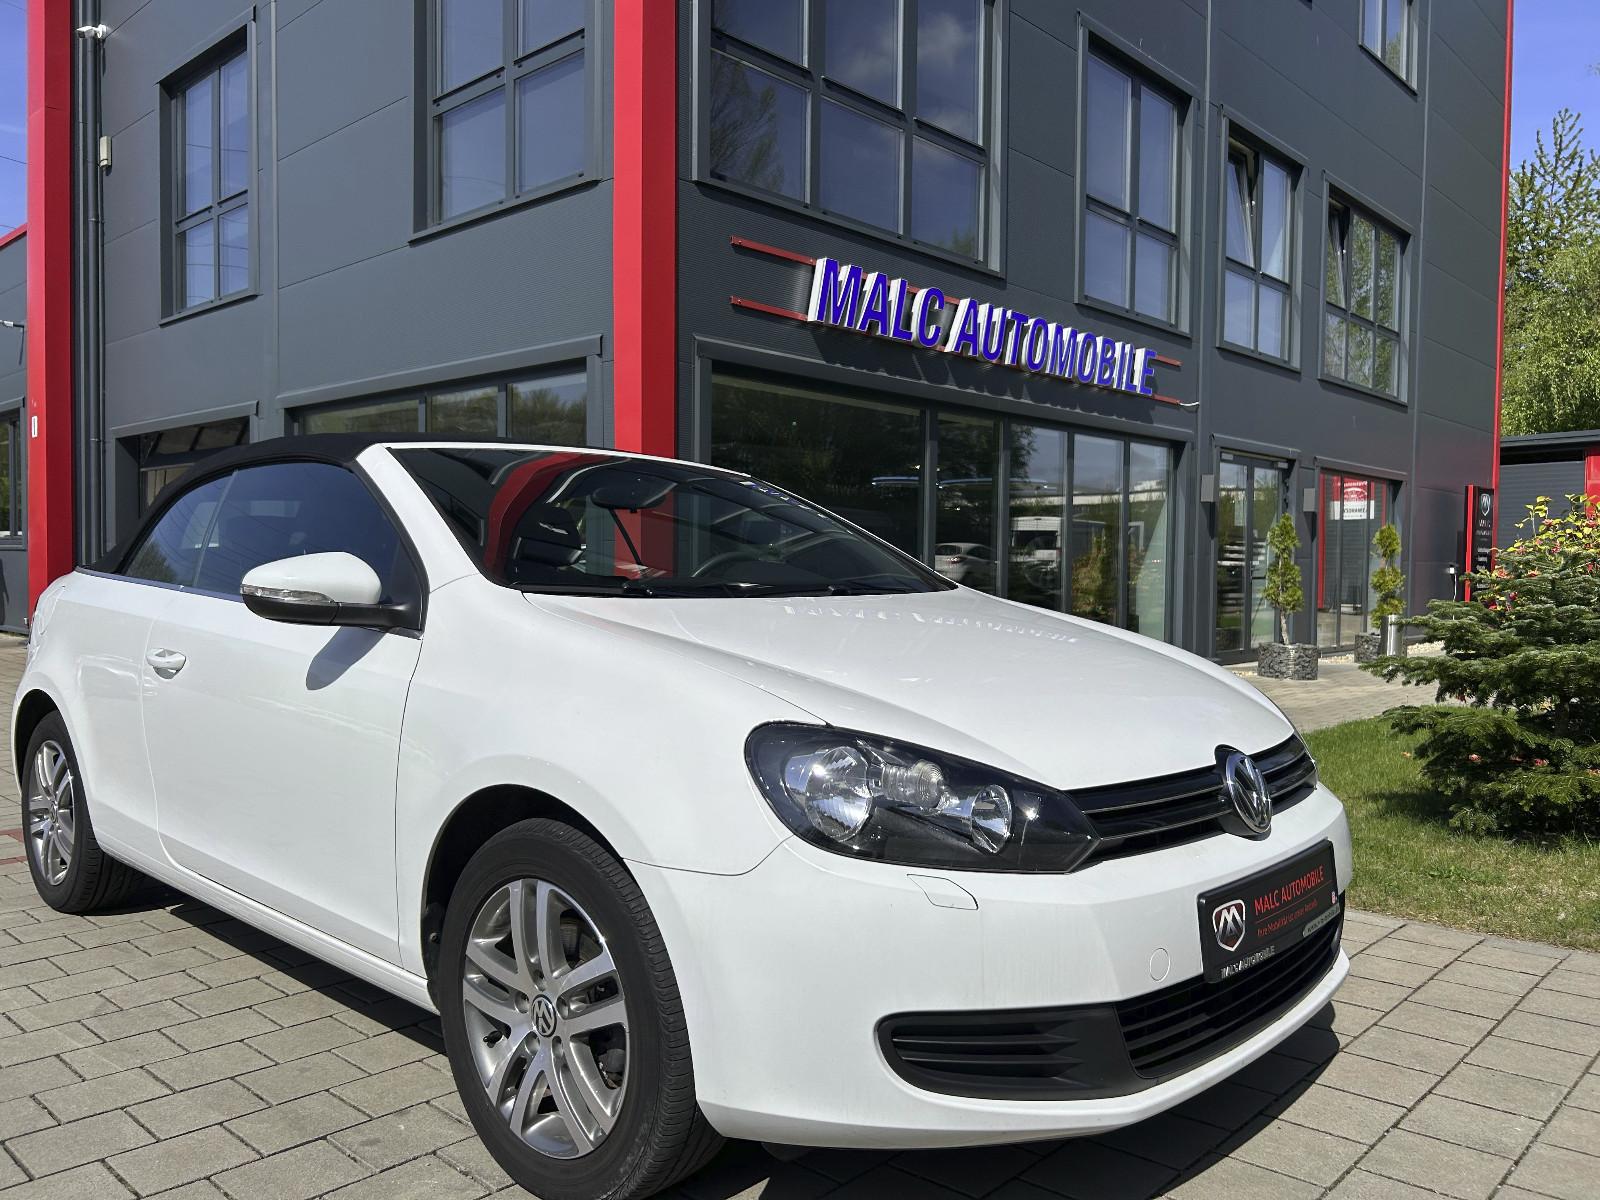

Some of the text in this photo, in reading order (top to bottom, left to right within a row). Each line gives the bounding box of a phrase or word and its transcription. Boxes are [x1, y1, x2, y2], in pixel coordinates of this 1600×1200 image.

[807, 257, 1157, 395] MALC AUTOMOBILE
[1254, 865, 1325, 915] MALC AUTOMOBILE
